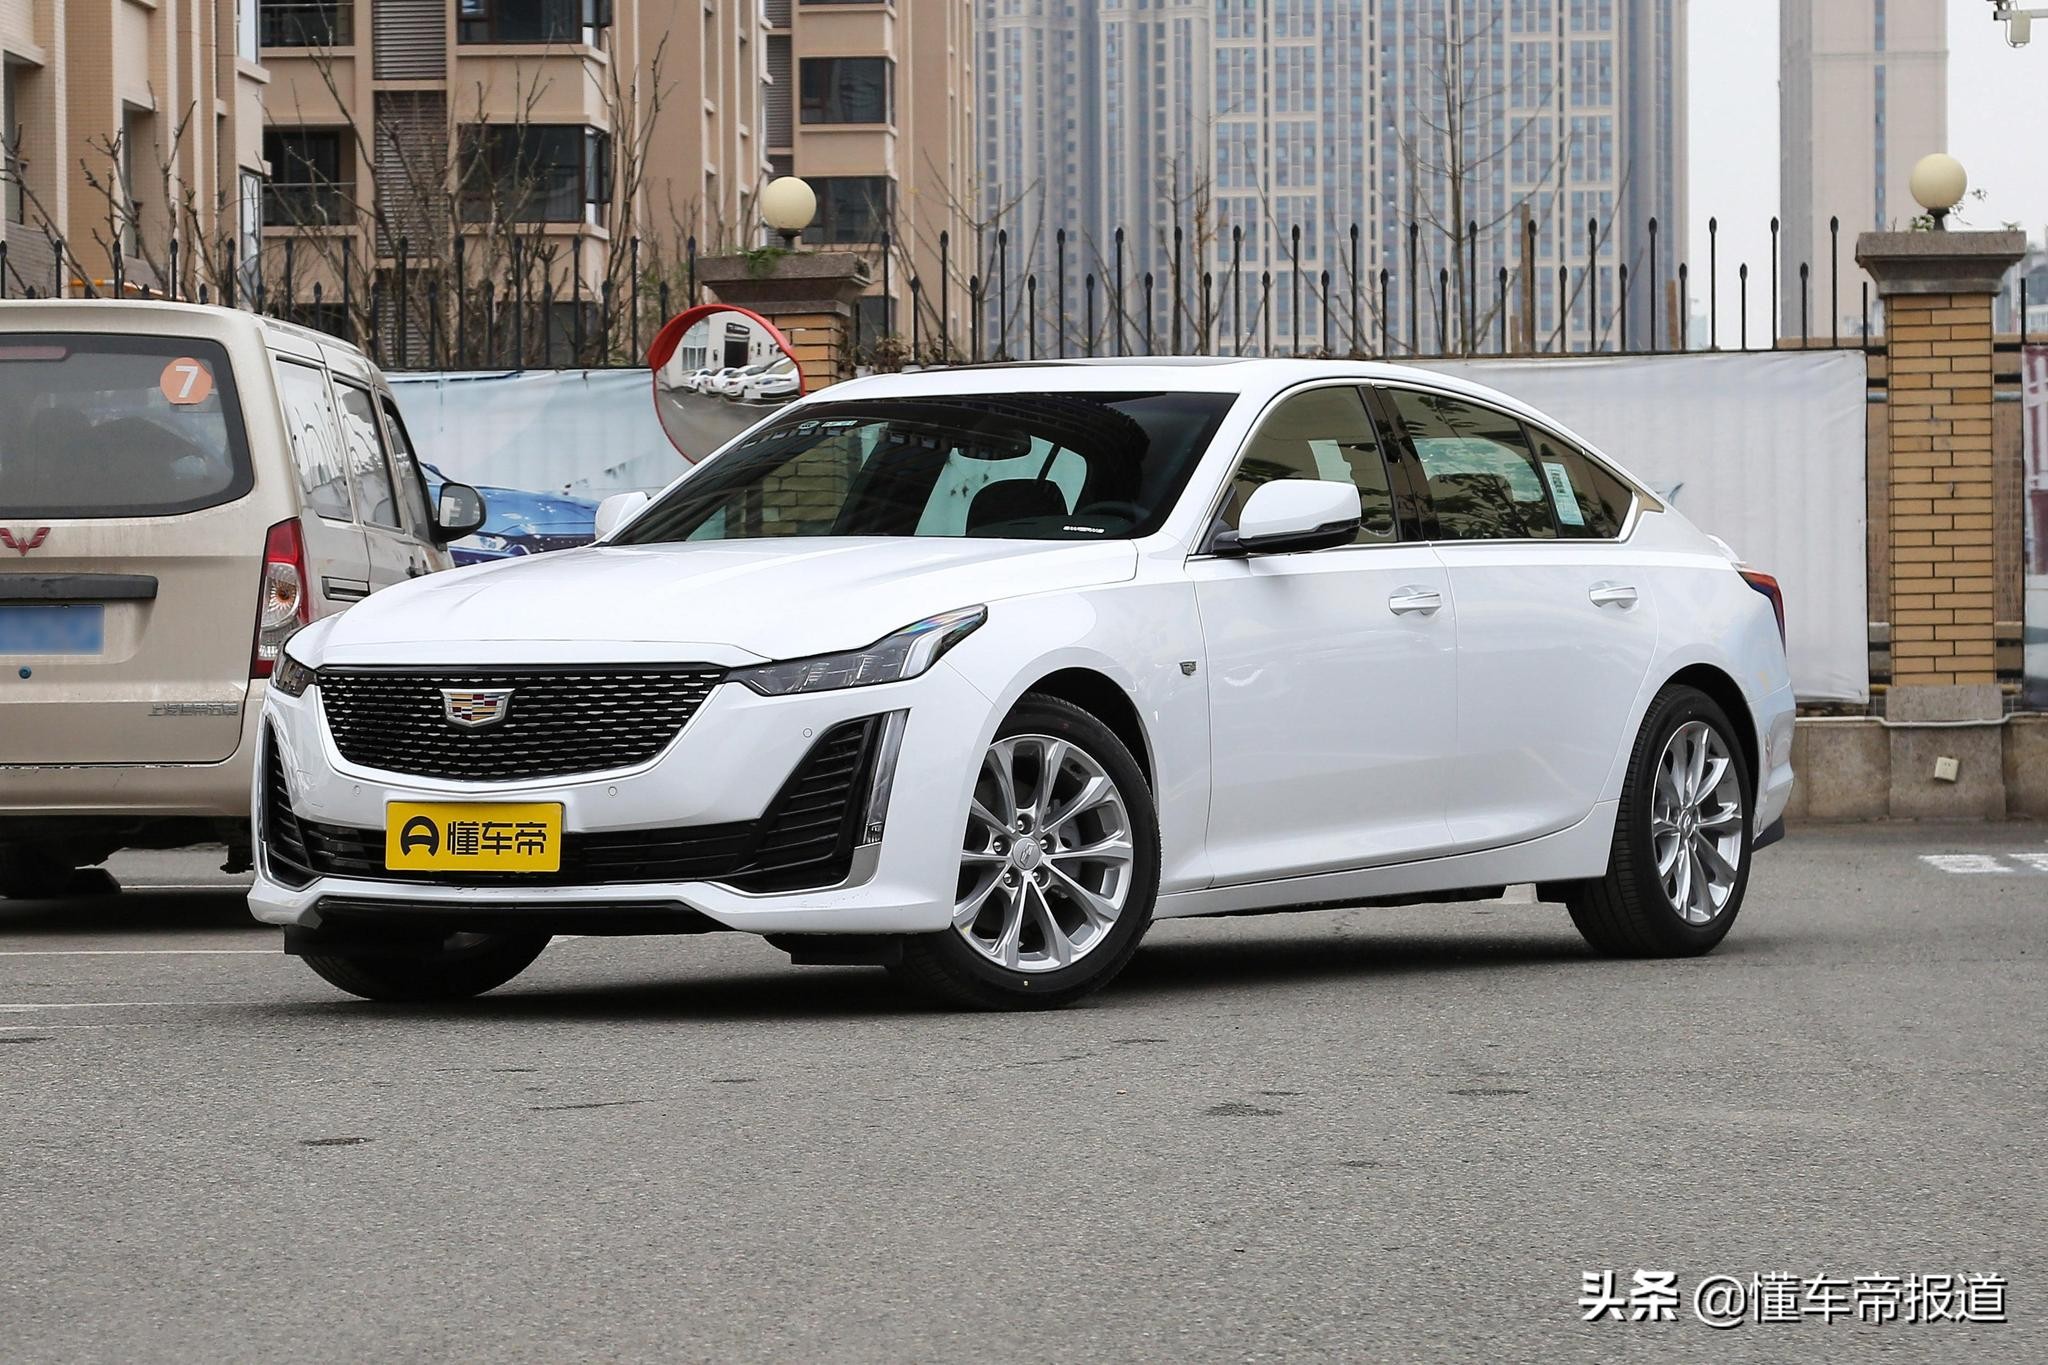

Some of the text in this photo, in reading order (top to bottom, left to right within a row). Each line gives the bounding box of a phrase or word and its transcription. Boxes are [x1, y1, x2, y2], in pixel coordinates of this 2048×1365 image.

[175, 365, 198, 398] 7
[447, 821, 547, 856] 懂车帝
